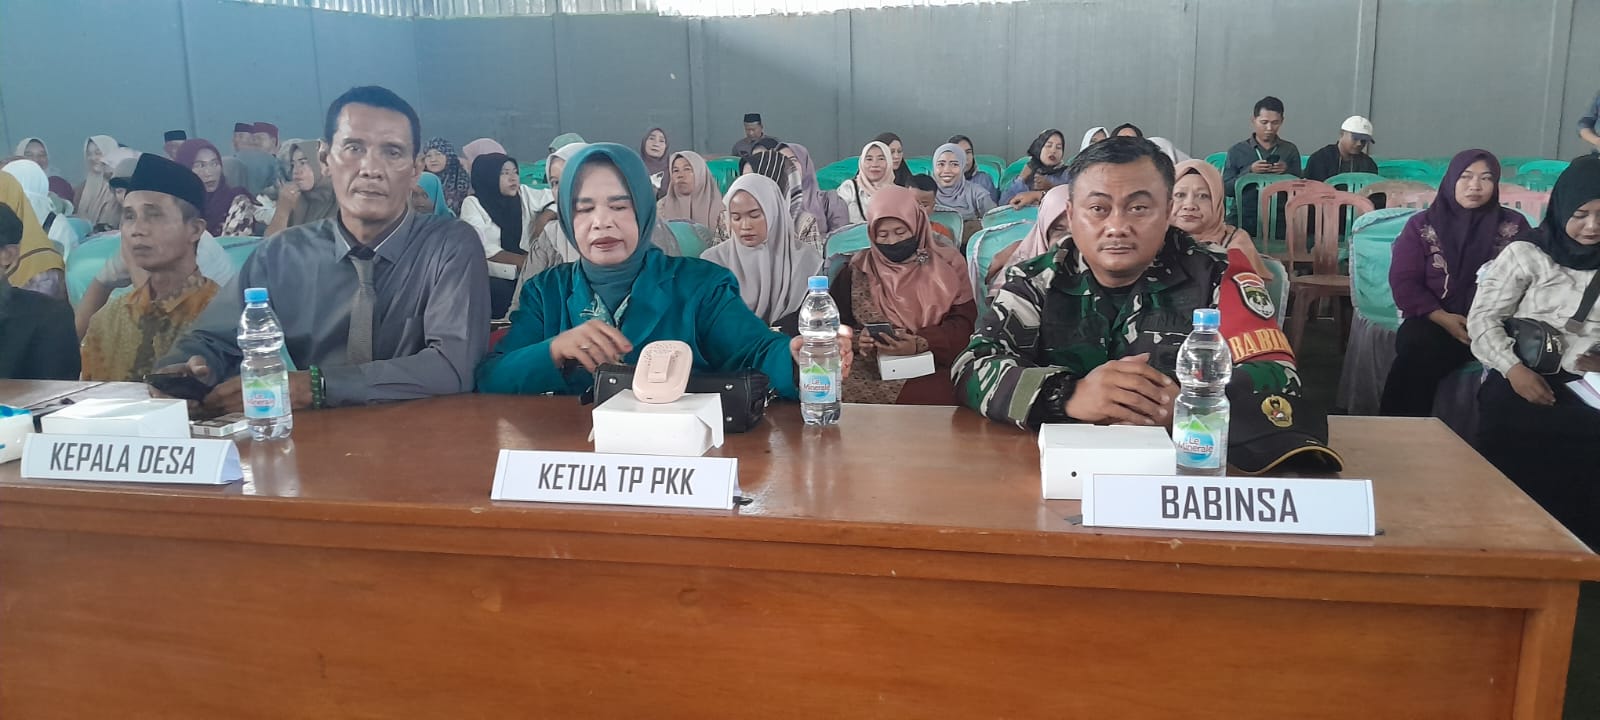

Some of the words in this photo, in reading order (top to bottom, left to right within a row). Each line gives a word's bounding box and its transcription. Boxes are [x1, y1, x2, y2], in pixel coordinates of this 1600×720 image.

[1189, 435, 1200, 446] Le
[50, 442, 130, 473] KEPALA
[137, 445, 196, 475] DESA
[537, 463, 607, 492] KETUA
[617, 465, 644, 493] TP
[650, 467, 696, 495] PKK
[1160, 485, 1299, 523] BABINSA
